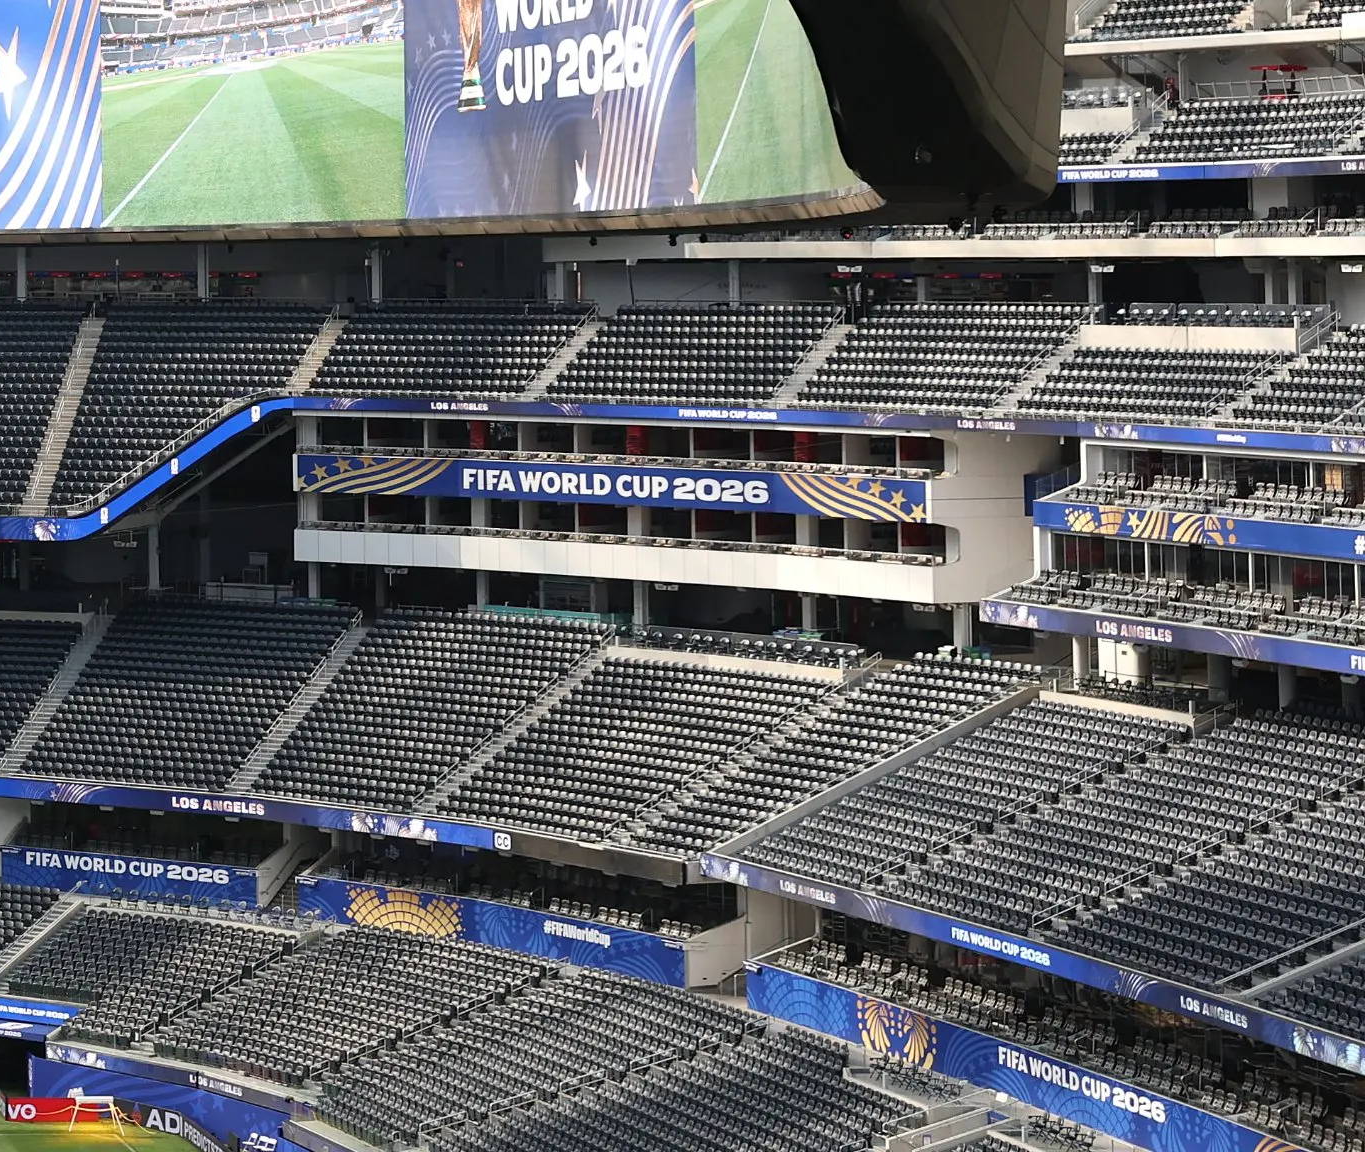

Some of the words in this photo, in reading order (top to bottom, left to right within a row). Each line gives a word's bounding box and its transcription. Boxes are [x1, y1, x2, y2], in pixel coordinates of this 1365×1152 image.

[495, 44, 552, 108] CUP
[556, 25, 650, 98] 2026
[1341, 161, 1357, 170] LOS
[430, 402, 450, 411] LOS
[450, 402, 488, 411] ANGELES
[957, 419, 975, 429] LOS
[976, 419, 1016, 431] ANGELES
[462, 468, 516, 492] FIFA
[519, 470, 612, 496] WORLD
[616, 474, 669, 499] CUP
[672, 477, 769, 504] 2026
[1096, 620, 1118, 636] LOS
[1120, 622, 1173, 643] ANGELES
[172, 796, 199, 810] LOS
[202, 798, 265, 816] ANGELES
[495, 834, 510, 848] CC
[25, 851, 61, 869] FIFA
[64, 853, 126, 874] WORLD
[130, 859, 163, 879] CUP
[166, 864, 229, 885] 2026
[780, 879, 797, 896] LOS
[798, 884, 836, 904] ANGELES
[543, 919, 611, 949] #FIFAWorldCup
[951, 926, 969, 942] FIFA
[970, 932, 1001, 954] WORLD
[1001, 939, 1019, 959] CUP
[1019, 945, 1051, 966] 2026
[1180, 995, 1200, 1014] LOS
[1202, 1001, 1249, 1028] ANGELES
[189, 1074, 207, 1087] LOS
[209, 1078, 243, 1097] ANGELES
[998, 1046, 1029, 1075] FIFA
[1030, 1055, 1078, 1092] WORLD
[1080, 1074, 1111, 1103] CUP
[1112, 1087, 1166, 1124] 2026
